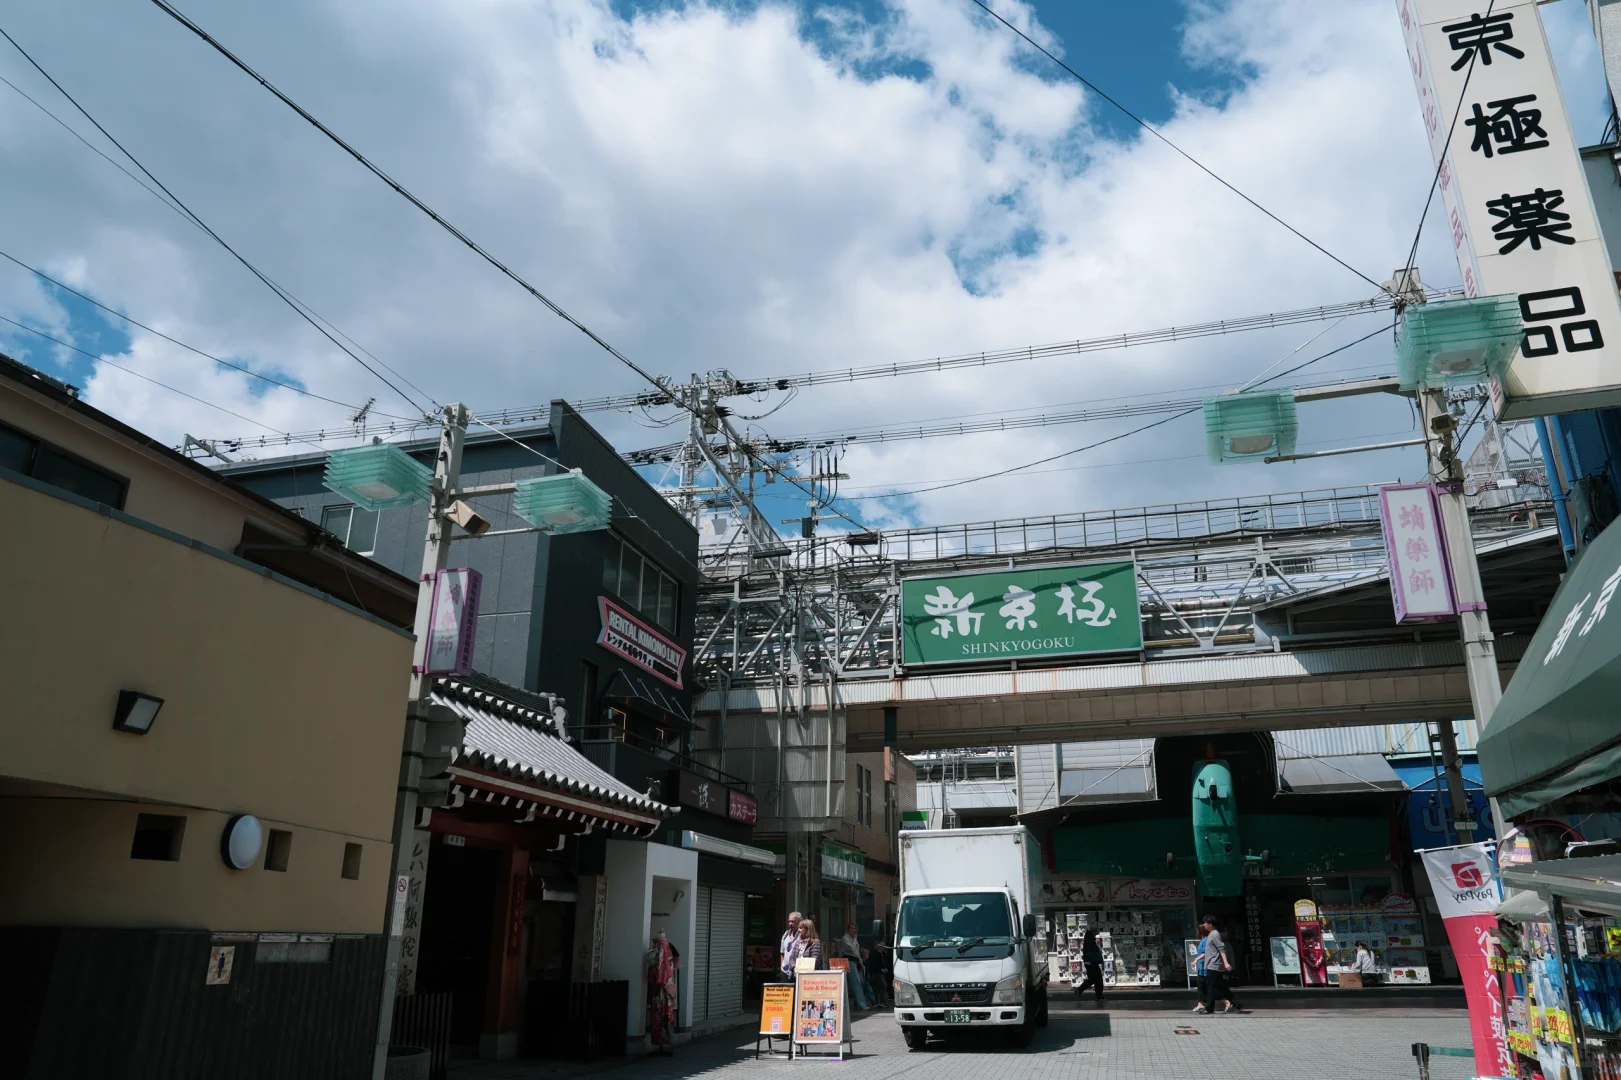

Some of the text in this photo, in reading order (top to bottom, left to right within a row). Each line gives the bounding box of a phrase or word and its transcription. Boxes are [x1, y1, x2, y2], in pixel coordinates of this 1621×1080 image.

[1441, 12, 1605, 358] 京極薬品
[923, 579, 1118, 639] 新京極
[608, 610, 682, 667] RENTAL KIMONO LILY
[962, 636, 1076, 655] SHINKYOGOKU
[730, 801, 757, 824] カステーラ
[1129, 886, 1189, 900] kyoto
[950, 1014, 970, 1023] 13-58
